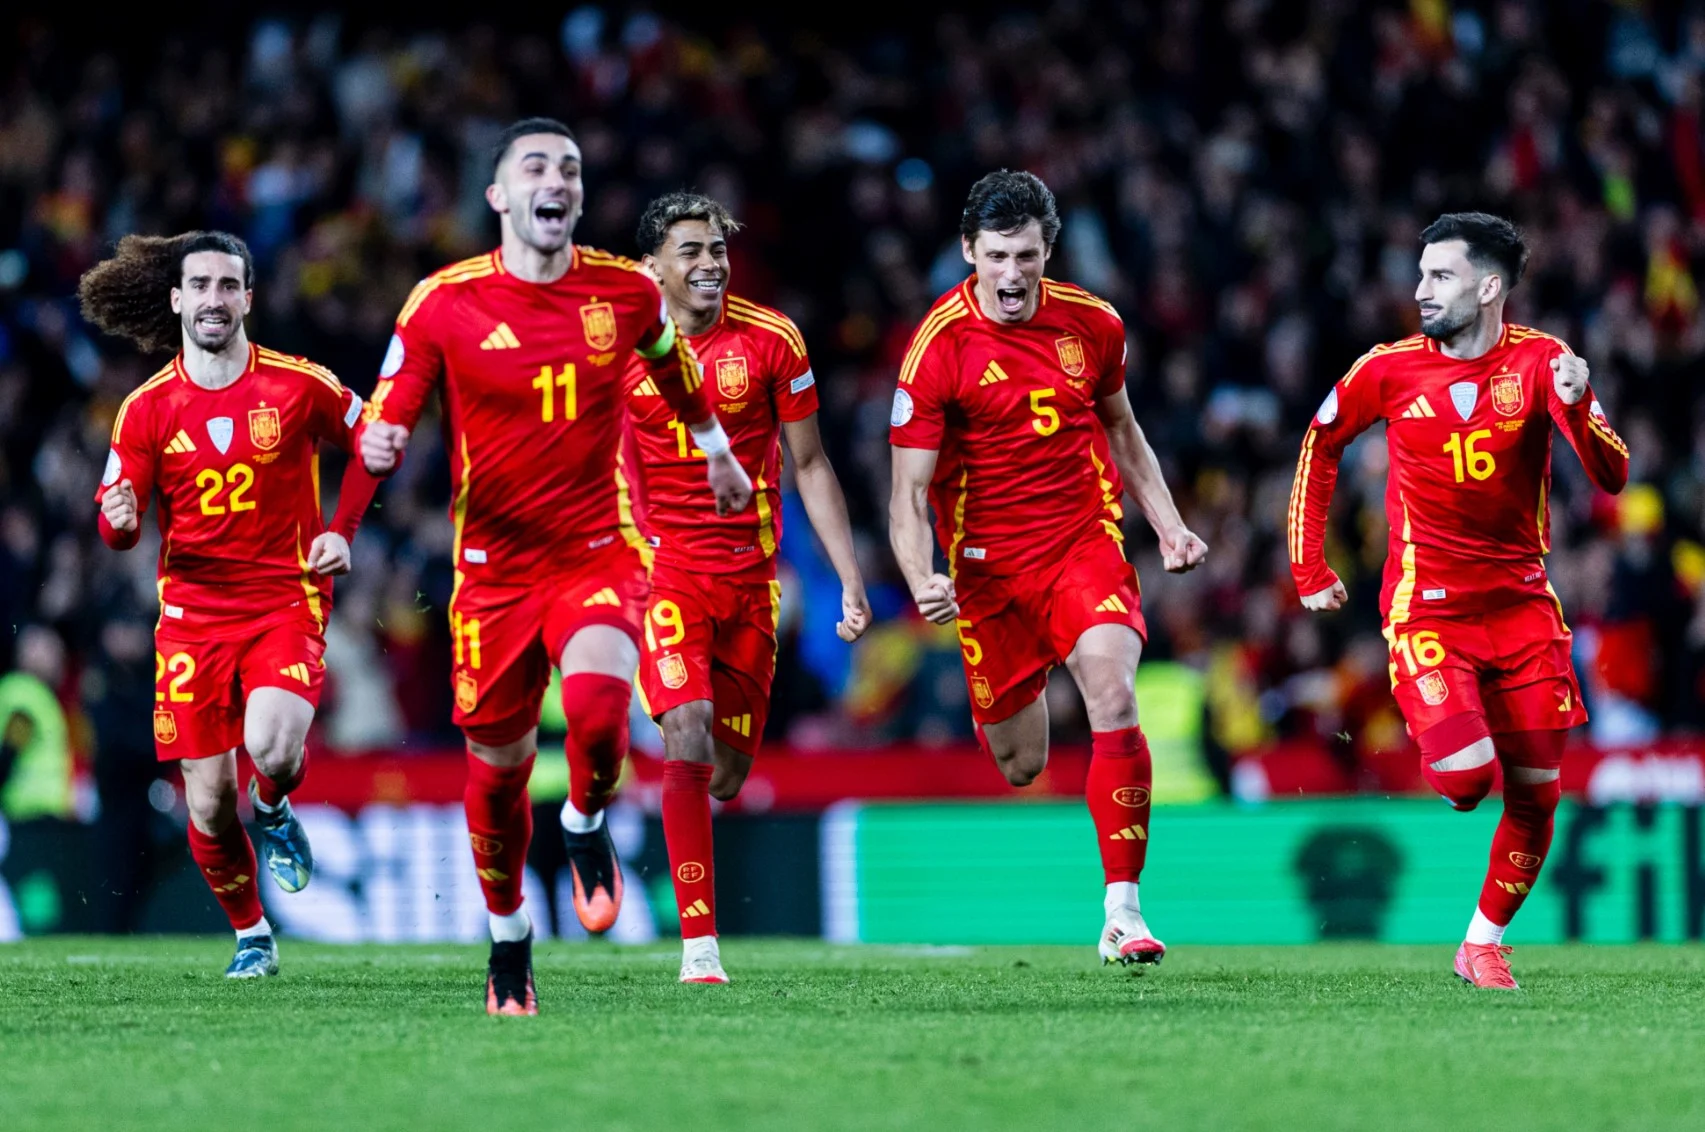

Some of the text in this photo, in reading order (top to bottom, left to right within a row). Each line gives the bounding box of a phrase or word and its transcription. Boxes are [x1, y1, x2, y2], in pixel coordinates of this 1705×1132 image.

[532, 363, 577, 422] 11
[1029, 388, 1060, 436] 5
[667, 418, 708, 458] 1
[1442, 429, 1496, 483] 16
[196, 463, 256, 516] 22
[453, 611, 481, 669] 11
[644, 600, 685, 653] 19
[956, 618, 983, 666] 5
[1395, 630, 1446, 676] 16
